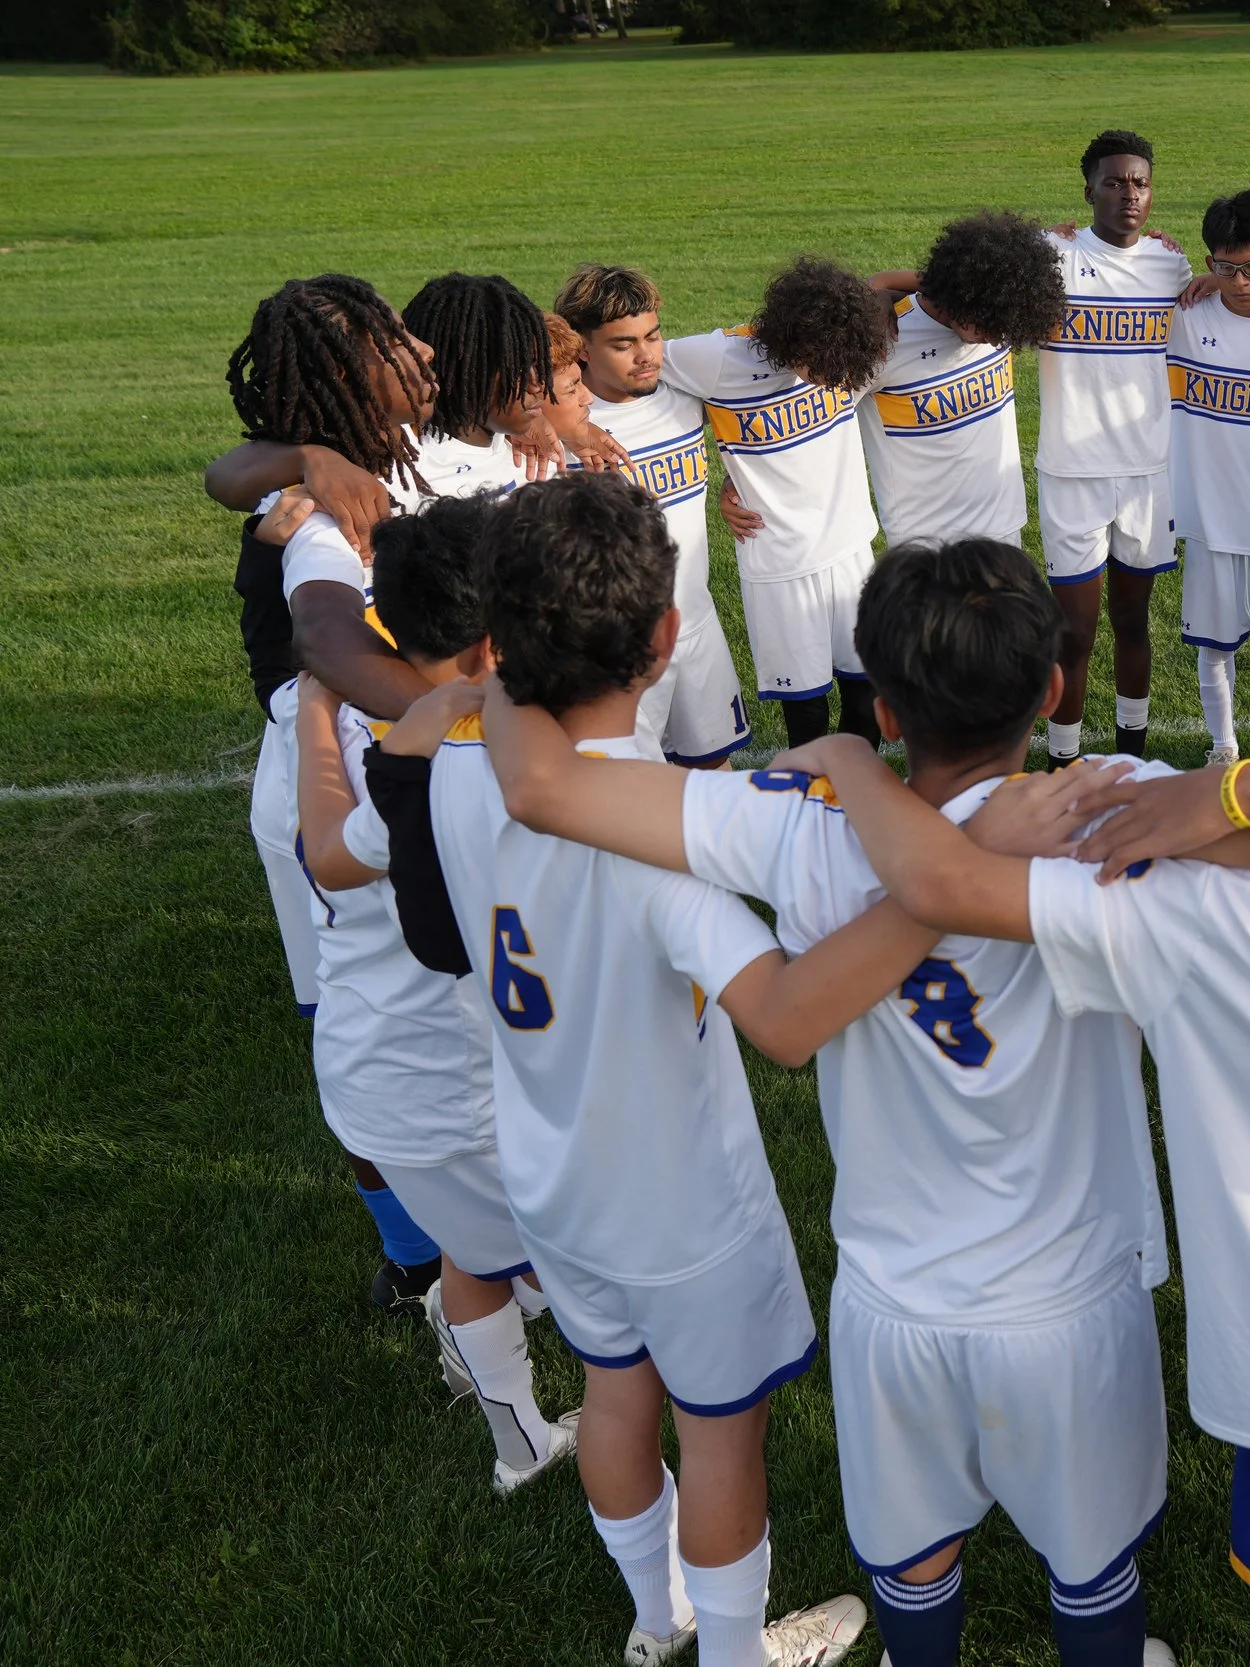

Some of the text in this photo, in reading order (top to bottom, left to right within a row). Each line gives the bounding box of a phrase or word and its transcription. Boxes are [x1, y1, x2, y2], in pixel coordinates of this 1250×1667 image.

[1061, 308, 1168, 341] KNIGHTS
[911, 359, 1009, 425] KNIGHTS
[489, 903, 556, 1033] 6
[897, 953, 996, 1069] 8
